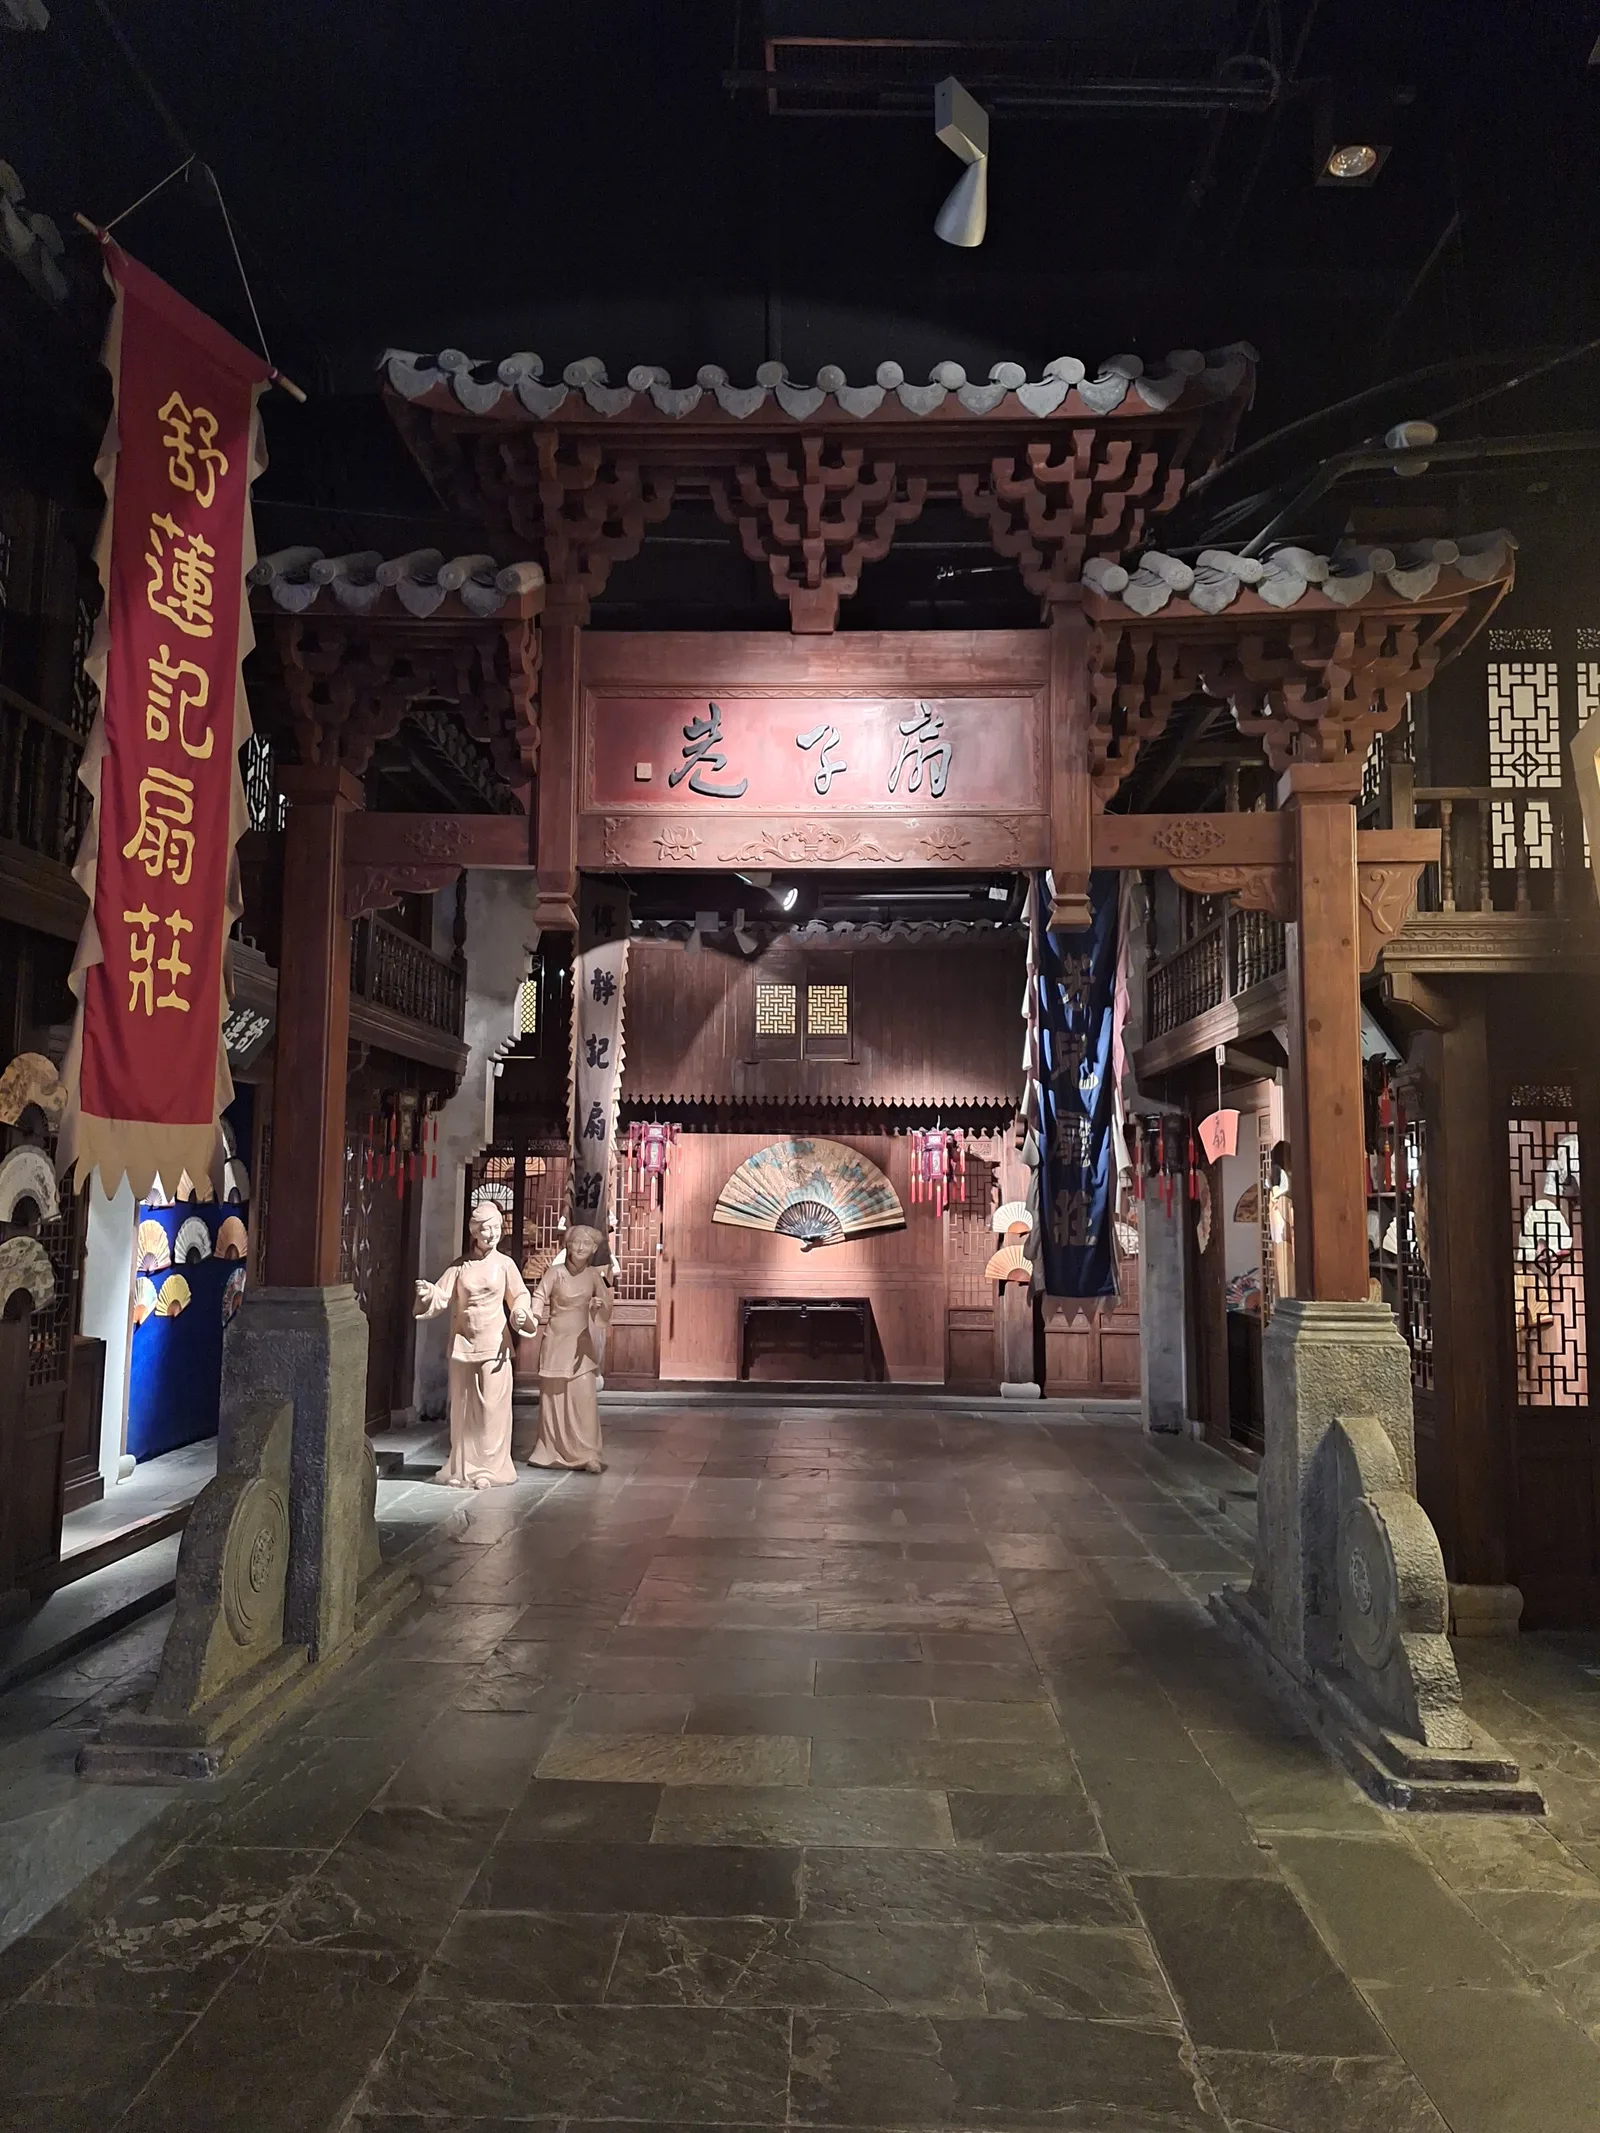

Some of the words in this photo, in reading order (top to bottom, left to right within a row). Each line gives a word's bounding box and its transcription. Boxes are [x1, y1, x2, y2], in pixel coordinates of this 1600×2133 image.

[122, 391, 228, 1016] 舒蓮記扇莊
